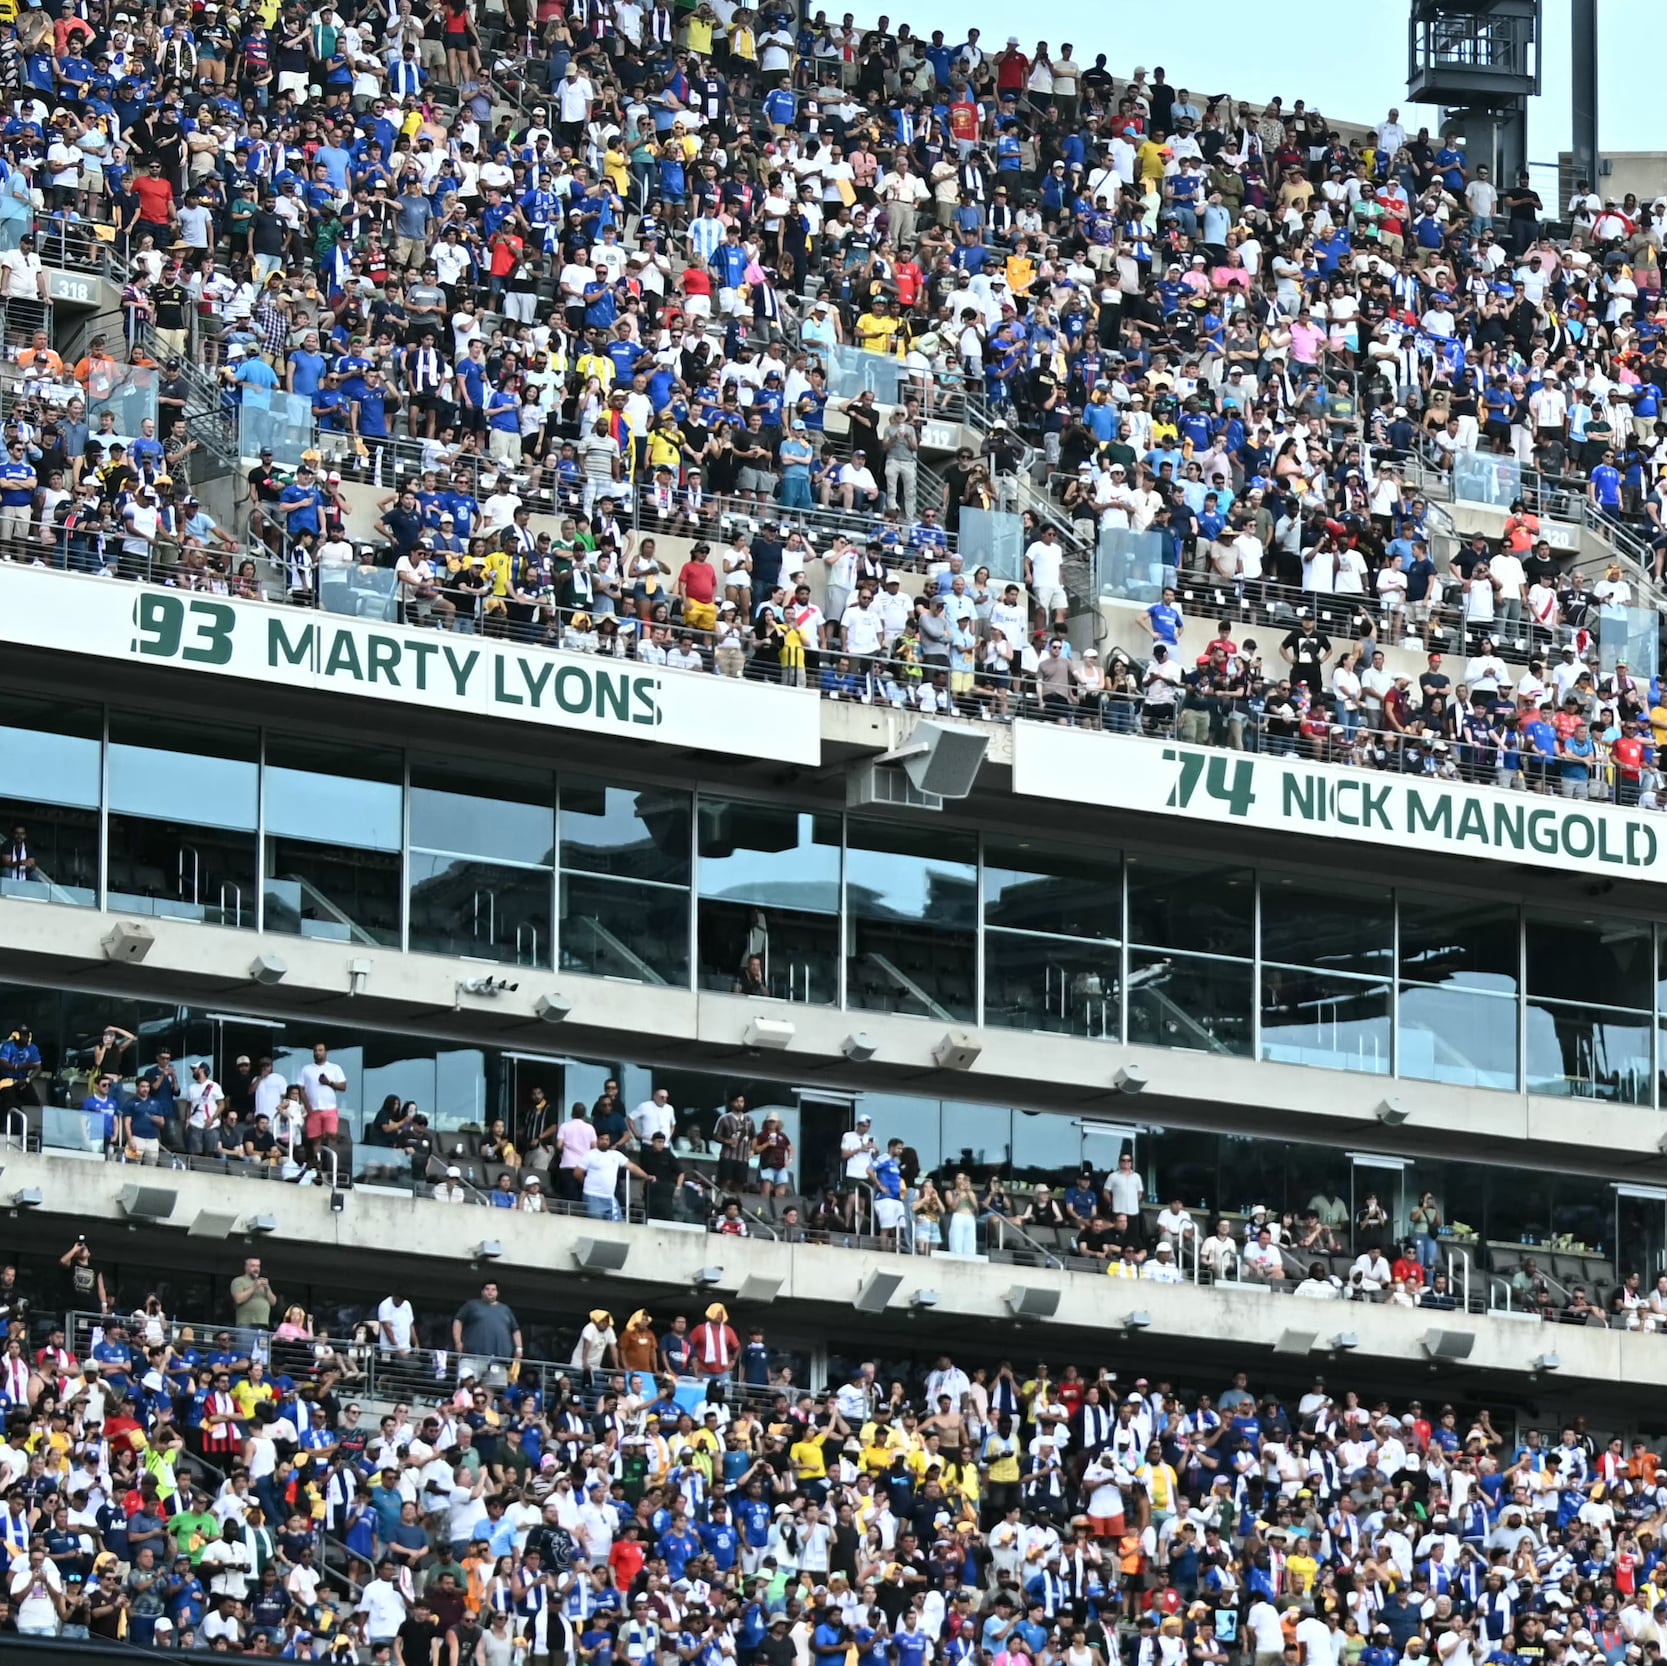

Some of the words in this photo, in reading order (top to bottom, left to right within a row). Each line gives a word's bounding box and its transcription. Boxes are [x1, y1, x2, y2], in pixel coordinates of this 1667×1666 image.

[60, 279, 88, 300] 318
[921, 425, 951, 447] 319
[131, 593, 238, 666] 93
[267, 617, 483, 699] MARTY
[494, 654, 664, 727] LYONS
[1161, 748, 1256, 818] 74
[1281, 772, 1395, 832] NICK
[1405, 788, 1659, 868] MANGOLD
